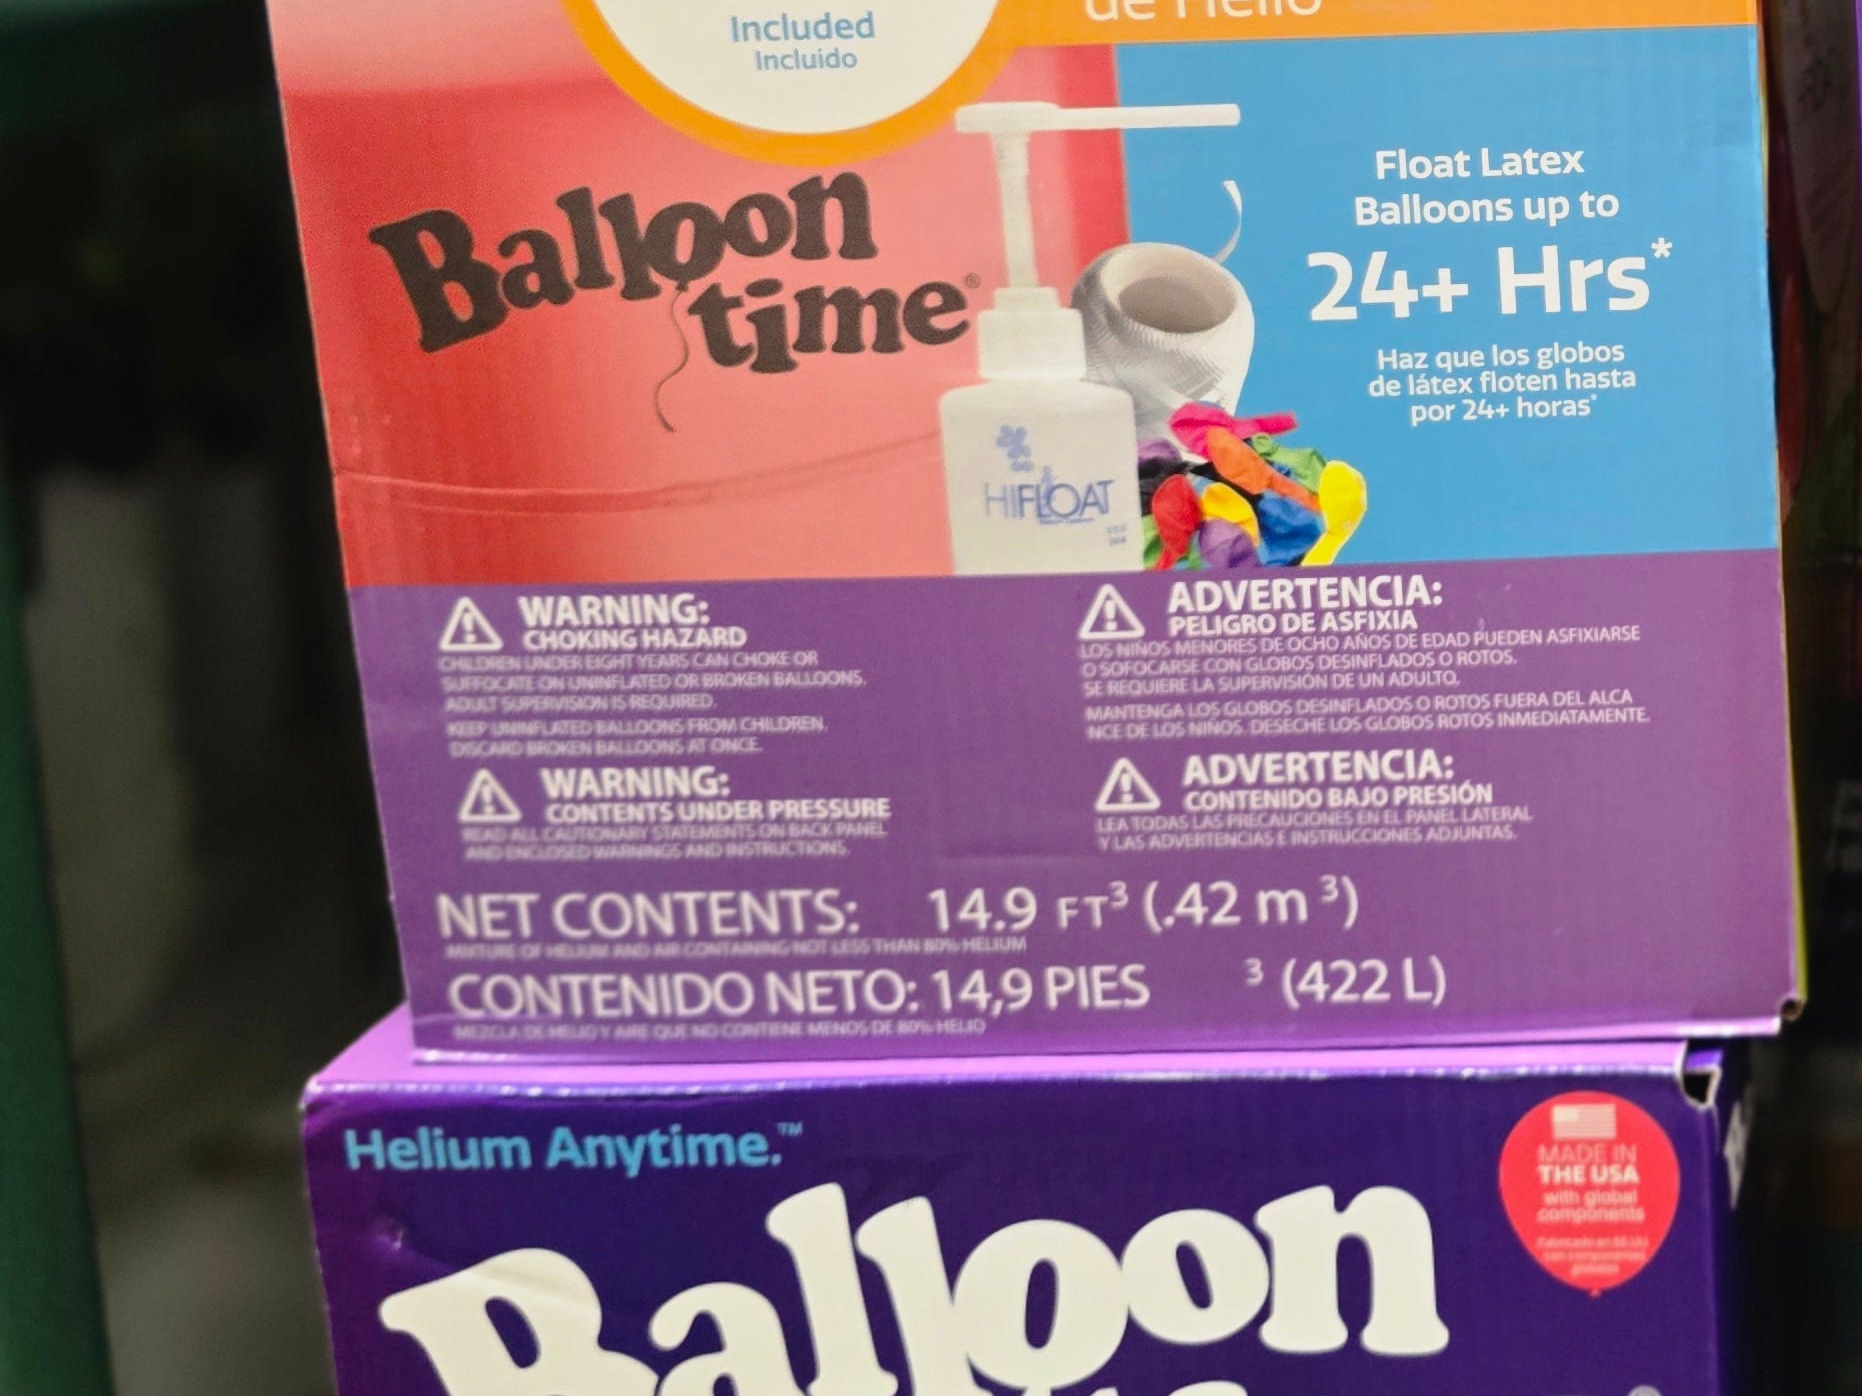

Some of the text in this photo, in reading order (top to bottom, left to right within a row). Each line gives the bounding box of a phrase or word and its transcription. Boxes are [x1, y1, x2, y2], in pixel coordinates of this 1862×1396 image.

[730, 10, 876, 43] Included
[754, 46, 858, 72] Incluido
[1375, 147, 1585, 180] Float Latex
[1354, 190, 1620, 228] Balloons up to
[369, 172, 879, 354] Balloon
[1307, 250, 1469, 321] 24+
[1377, 340, 1625, 374] Haz que los globos
[1367, 367, 1637, 398] de látex floten hasta
[1410, 403, 1456, 427] por
[1461, 398, 1510, 421] 24+
[517, 592, 710, 629] WARNING:
[1167, 574, 1443, 614] ADVERTENCIA:
[522, 625, 748, 652] CHOKING HAZARD
[1168, 608, 1419, 638] PELIGRO DE ASFIXIA
[344, 1125, 532, 1171] Helium
